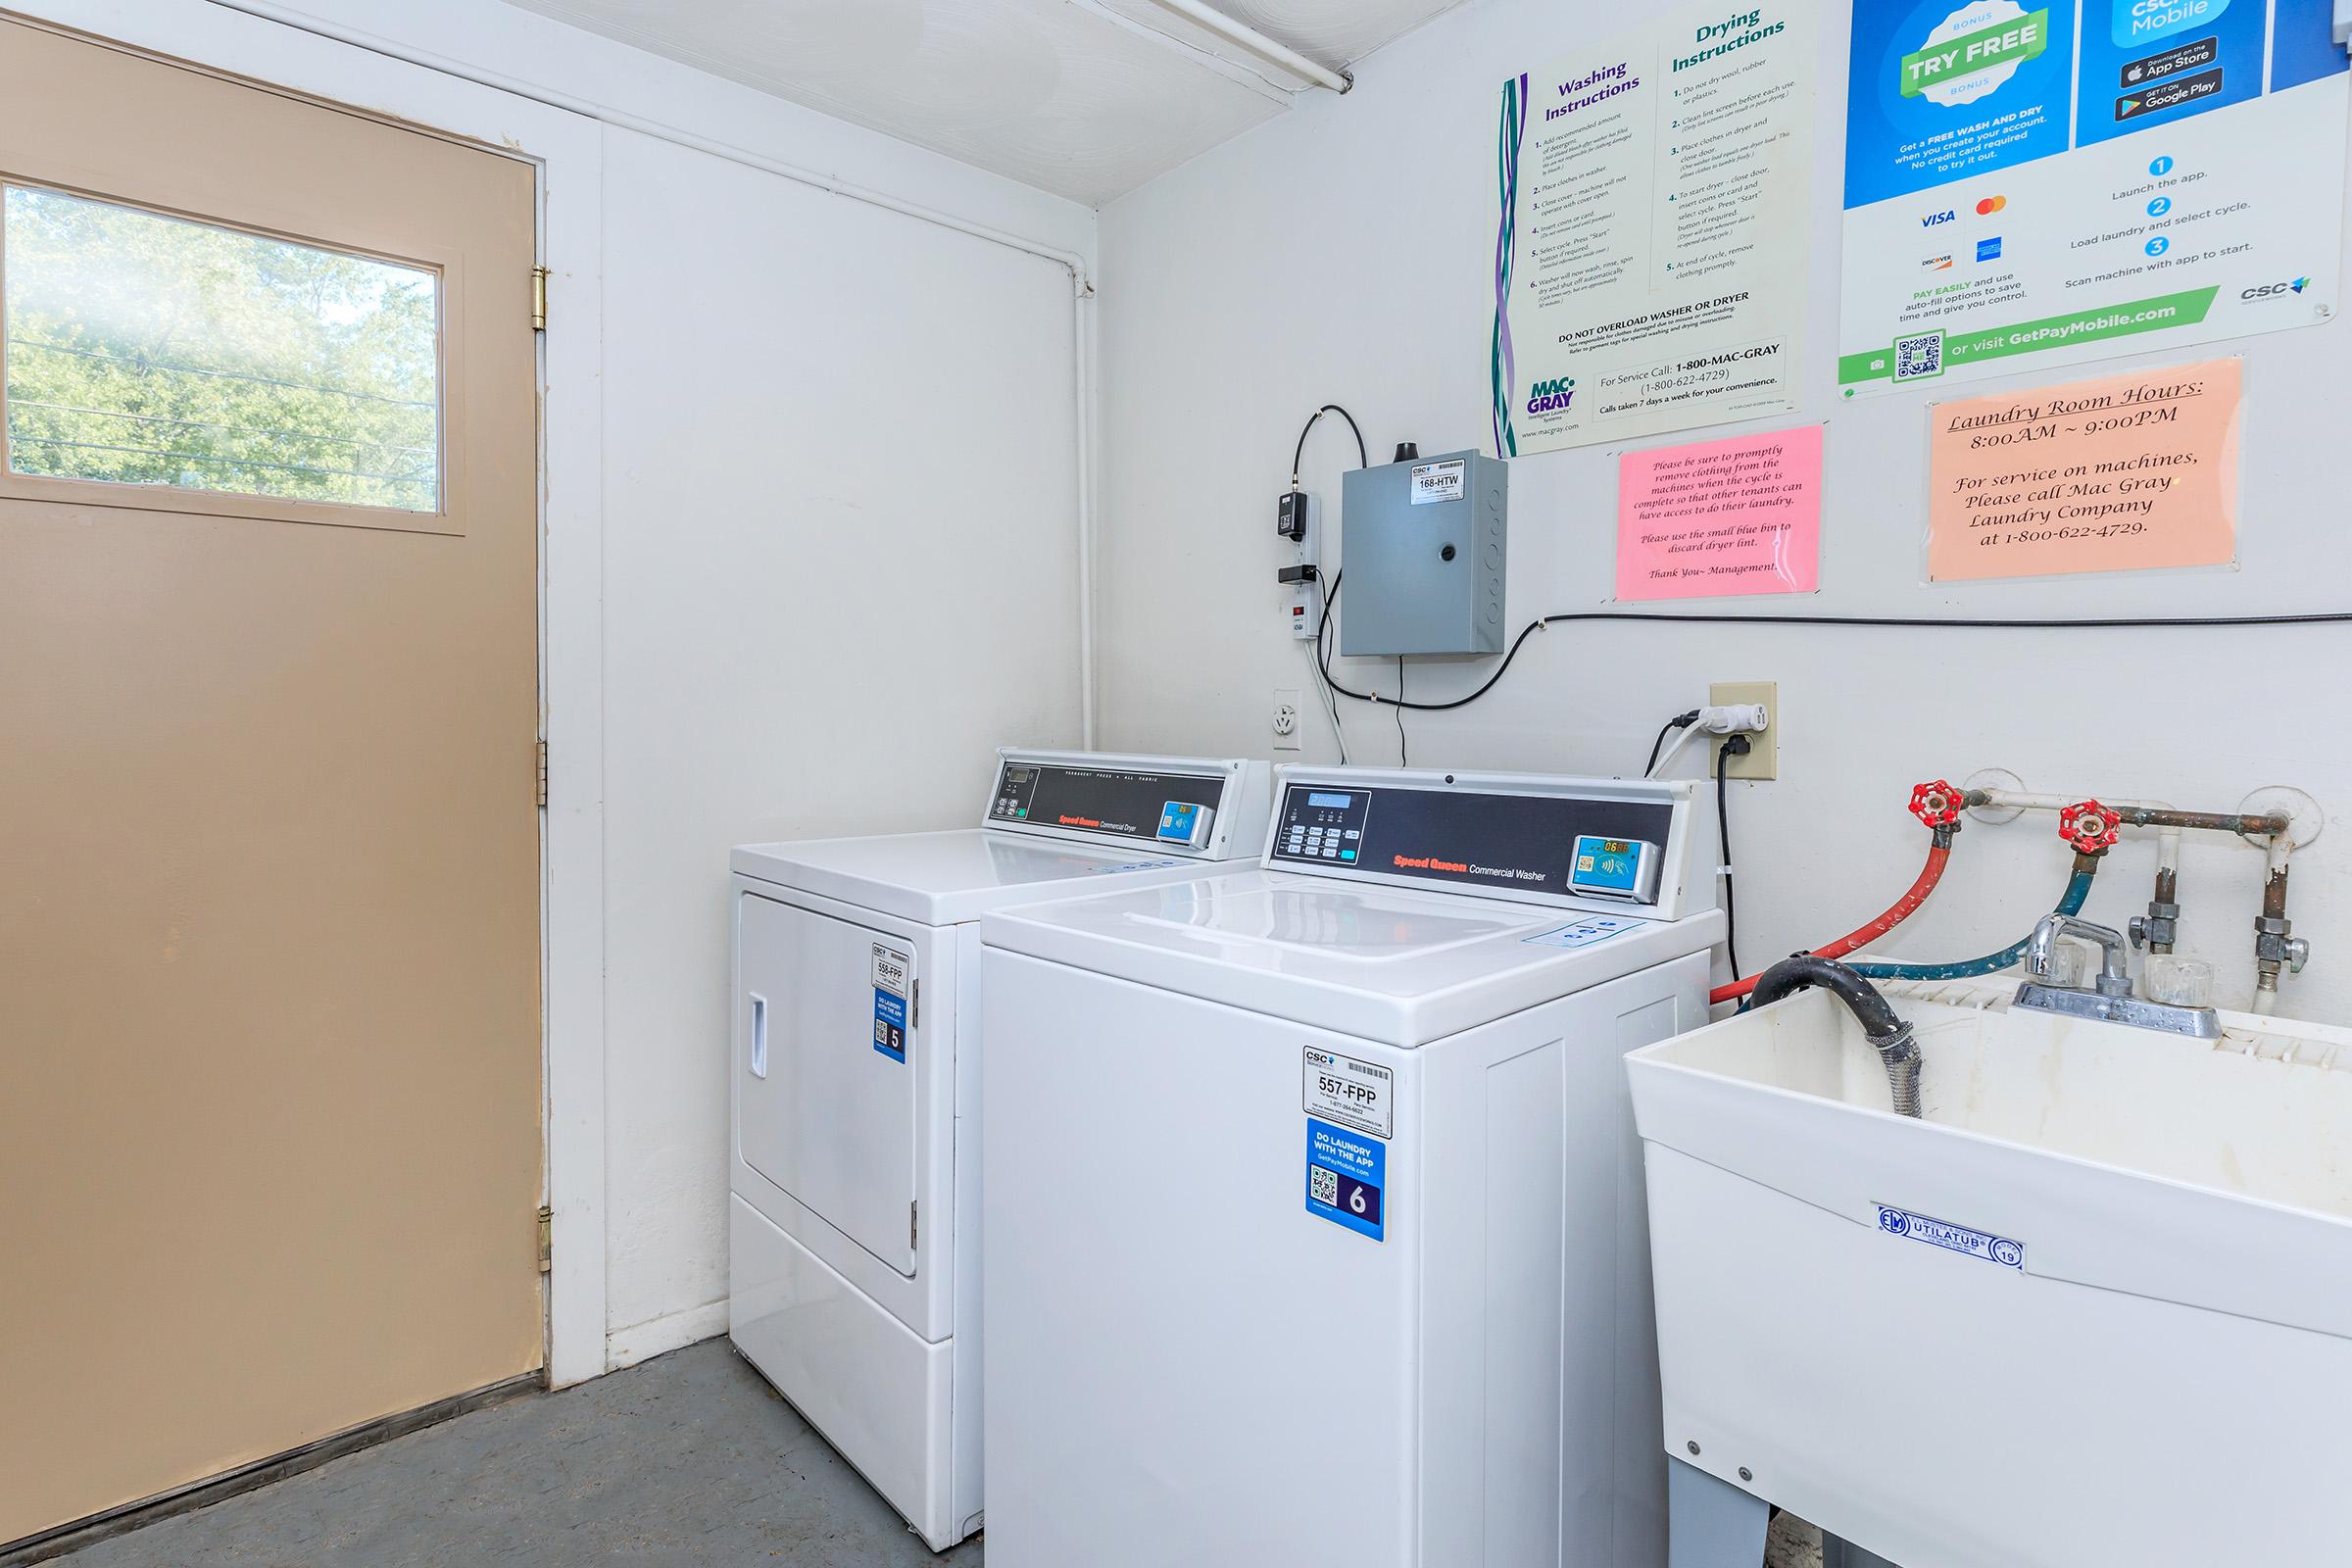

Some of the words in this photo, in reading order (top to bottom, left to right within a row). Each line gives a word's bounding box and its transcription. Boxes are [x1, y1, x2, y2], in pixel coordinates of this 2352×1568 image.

[1696, 9, 1760, 42] Drying
[1952, 13, 1992, 30] BONUS
[2132, 1, 2208, 35] Mobile
[1673, 22, 1785, 73] Instructions
[1909, 49, 1959, 80] TRY
[1966, 24, 2038, 63] FREE
[2147, 51, 2181, 66] Download
[2147, 63, 2173, 76] App
[2176, 52, 2209, 68] Store
[1558, 63, 1627, 97] Washing
[1950, 78, 1988, 94] BONUS
[1545, 77, 1640, 122] Instructions
[2146, 89, 2188, 107] Google
[2190, 82, 2216, 94] Play
[1894, 153, 1920, 165] when
[1923, 147, 1940, 158] you
[1943, 137, 1974, 150] create
[1978, 129, 1999, 142] your
[2003, 117, 2046, 133] account.
[1899, 143, 1917, 153] Get
[1928, 130, 1954, 146] FREE
[1957, 122, 1989, 137] WASH
[1992, 113, 2017, 126] AND
[2019, 105, 2043, 119] DRY
[1911, 157, 1926, 170] No
[1929, 152, 1956, 165] credit
[1959, 142, 1981, 157] card
[1984, 130, 2028, 149] required
[1951, 158, 1965, 169] try
[1978, 151, 1997, 161] out.
[2113, 184, 2154, 200] Launch
[2159, 179, 2177, 188] the
[2181, 172, 2207, 182] app.
[1922, 211, 1956, 226] VISA
[2071, 236, 2098, 249] Load
[2102, 226, 2145, 241] laundry
[2149, 219, 2171, 230] and
[2176, 211, 2210, 224] select
[2215, 203, 2250, 215] cycle.
[1922, 255, 1952, 266] DISCOVER
[2066, 278, 2091, 288] Scan
[2095, 268, 2142, 281] machine
[2147, 260, 2172, 270] with
[2176, 255, 2199, 265] app
[2221, 244, 2253, 256] start.
[1906, 298, 1942, 311] auto-fill
[1945, 291, 1982, 303] options
[1999, 282, 2021, 292] save
[1913, 289, 1933, 300] PAY
[1936, 281, 1972, 296] EASILY
[1975, 277, 1993, 287] and
[1996, 273, 2014, 282] use
[1559, 334, 1573, 343] DO
[1575, 328, 1594, 339] NOT
[1597, 317, 1647, 333] OVERLOAD
[1650, 306, 1691, 320] WASHER
[1695, 301, 1710, 311] OR
[1714, 292, 1748, 307] DRYER
[1923, 308, 1940, 318] and
[1944, 305, 1964, 315] give
[1968, 301, 1985, 310] you
[1988, 291, 2027, 304] control.
[1952, 345, 1968, 355] or
[1974, 337, 2004, 351] visit
[2010, 308, 2176, 345] GetPayMobile.com
[1600, 377, 1615, 387] For
[1617, 370, 1649, 384] Service
[1651, 366, 1673, 378] Call:
[1676, 344, 1780, 373] 1-800-MAC-GRAY
[1641, 368, 1730, 396] (1-800-622-4729)
[1527, 392, 1574, 414] GRAY
[1599, 403, 1616, 415] Calls
[1618, 401, 1638, 411] taken
[1646, 396, 1663, 408] days
[1671, 391, 1690, 400] week
[1691, 388, 1703, 397] for
[1705, 387, 1725, 397] your
[1726, 378, 1778, 392] convenience.
[1947, 404, 2040, 432] Laundry
[2047, 394, 2118, 416] Room
[2120, 381, 2204, 406] Hours:
[1522, 423, 1579, 438] www.macgray.com
[1971, 424, 2056, 449] 8:00AM
[2084, 407, 2177, 435] 9:00PM
[1653, 462, 1682, 470] Please
[1685, 458, 1694, 466] be
[1697, 456, 1718, 465] sure
[1732, 446, 1783, 463] promptly
[1655, 472, 1690, 482] remove
[1692, 466, 1732, 477] clothing
[1733, 463, 1759, 475] from
[1763, 460, 1779, 468] the
[1420, 475, 1458, 488] 168-HTW
[1651, 483, 1693, 494] machines
[1698, 479, 1723, 488] when
[1727, 476, 1742, 485] the
[1745, 472, 1771, 485] cycle
[1953, 478, 1986, 493] For
[1992, 469, 2056, 486] service
[2064, 466, 2086, 477] on
[2095, 454, 2197, 473] machines,
[1966, 493, 2021, 508] Please
[2028, 484, 2066, 502] call
[2067, 483, 2111, 497] Mac
[2120, 477, 2172, 494] Gray
[1970, 508, 2050, 527] Laundry
[2058, 501, 2152, 519] Company
[1981, 534, 1999, 546] at
[2007, 523, 2146, 543] 1-800-622-4729.
[1058, 814, 1079, 825] Speed
[1079, 817, 1100, 827] Queen
[1101, 820, 1124, 830] Commercial
[1124, 822, 1137, 832] Dryer
[1394, 855, 1430, 869] Speed
[1430, 858, 1467, 872] Queen
[1469, 864, 1514, 878] Commercial
[1516, 869, 1546, 881] Washer
[878, 962, 902, 979] 558-FPP
[892, 1029, 899, 1048] 5
[1306, 1052, 1327, 1063] CSC
[1319, 1076, 1377, 1104] 557-FPP
[1314, 1140, 1336, 1154] WITH
[1337, 1147, 1354, 1161] THE
[1356, 1153, 1374, 1168] APP
[1317, 1132, 1329, 1144] DO
[1331, 1136, 1371, 1157] LAUNDRY
[1317, 1153, 1369, 1176] GetPayMobile.com
[1349, 1186, 1367, 1213] 6
[2001, 1252, 2014, 1261] 19
